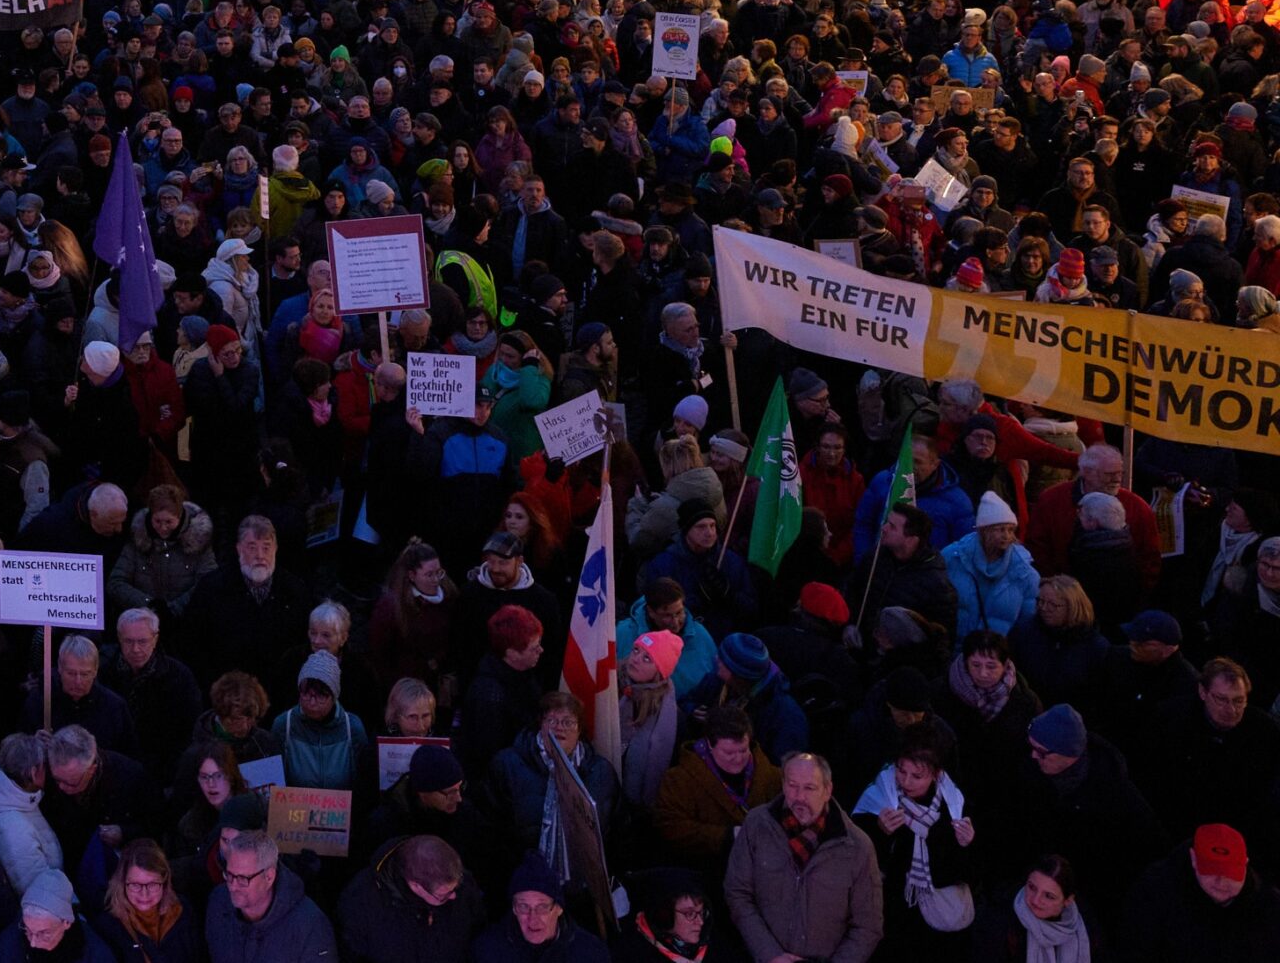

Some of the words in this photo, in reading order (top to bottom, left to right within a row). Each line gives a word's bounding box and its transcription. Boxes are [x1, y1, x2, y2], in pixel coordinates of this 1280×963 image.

[744, 261, 799, 292] WIR
[806, 276, 916, 318] TRETEN
[800, 303, 848, 333] EIN
[856, 316, 909, 350] FÜR
[410, 357, 426, 367] Wir
[433, 357, 461, 370] haben
[410, 370, 427, 378] aus
[433, 368, 450, 378] der
[410, 378, 463, 393] Geschichte
[410, 390, 452, 405] gelernt!
[541, 414, 567, 431] Hass
[575, 399, 592, 416] und
[1, 559, 97, 573] MENSCHENRECHTE
[1, 577, 23, 585] statt
[288, 809, 306, 823] IST
